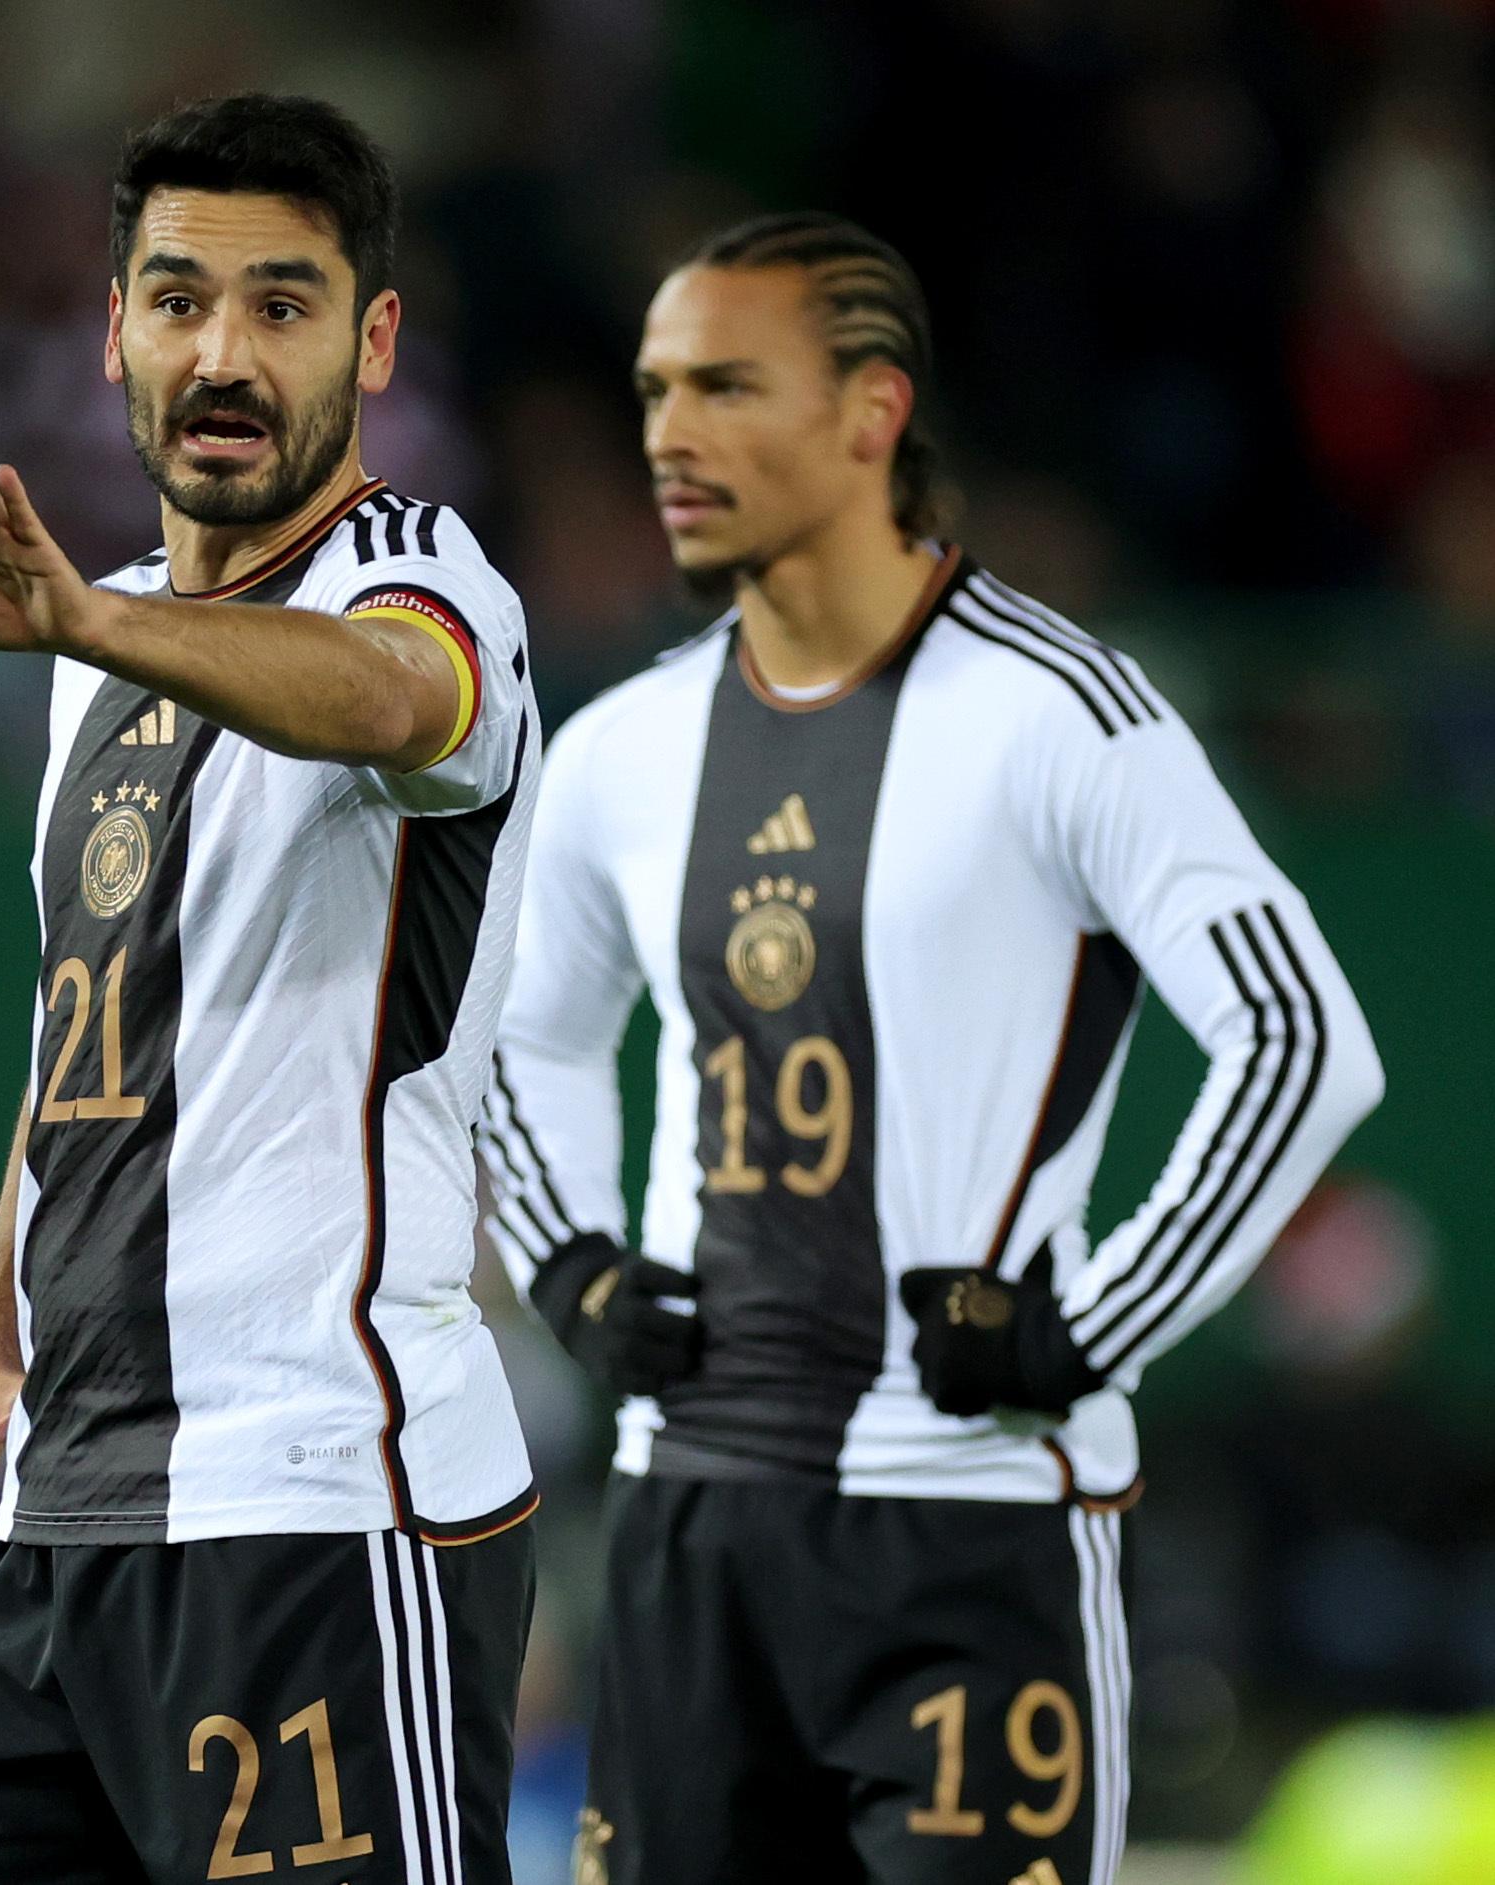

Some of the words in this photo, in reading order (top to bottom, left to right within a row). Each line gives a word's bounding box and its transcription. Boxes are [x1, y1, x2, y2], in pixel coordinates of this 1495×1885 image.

[39, 946, 147, 1123] 21
[705, 1036, 853, 1197] 19
[188, 1697, 375, 1880] 21
[906, 1679, 1084, 1839] 19
